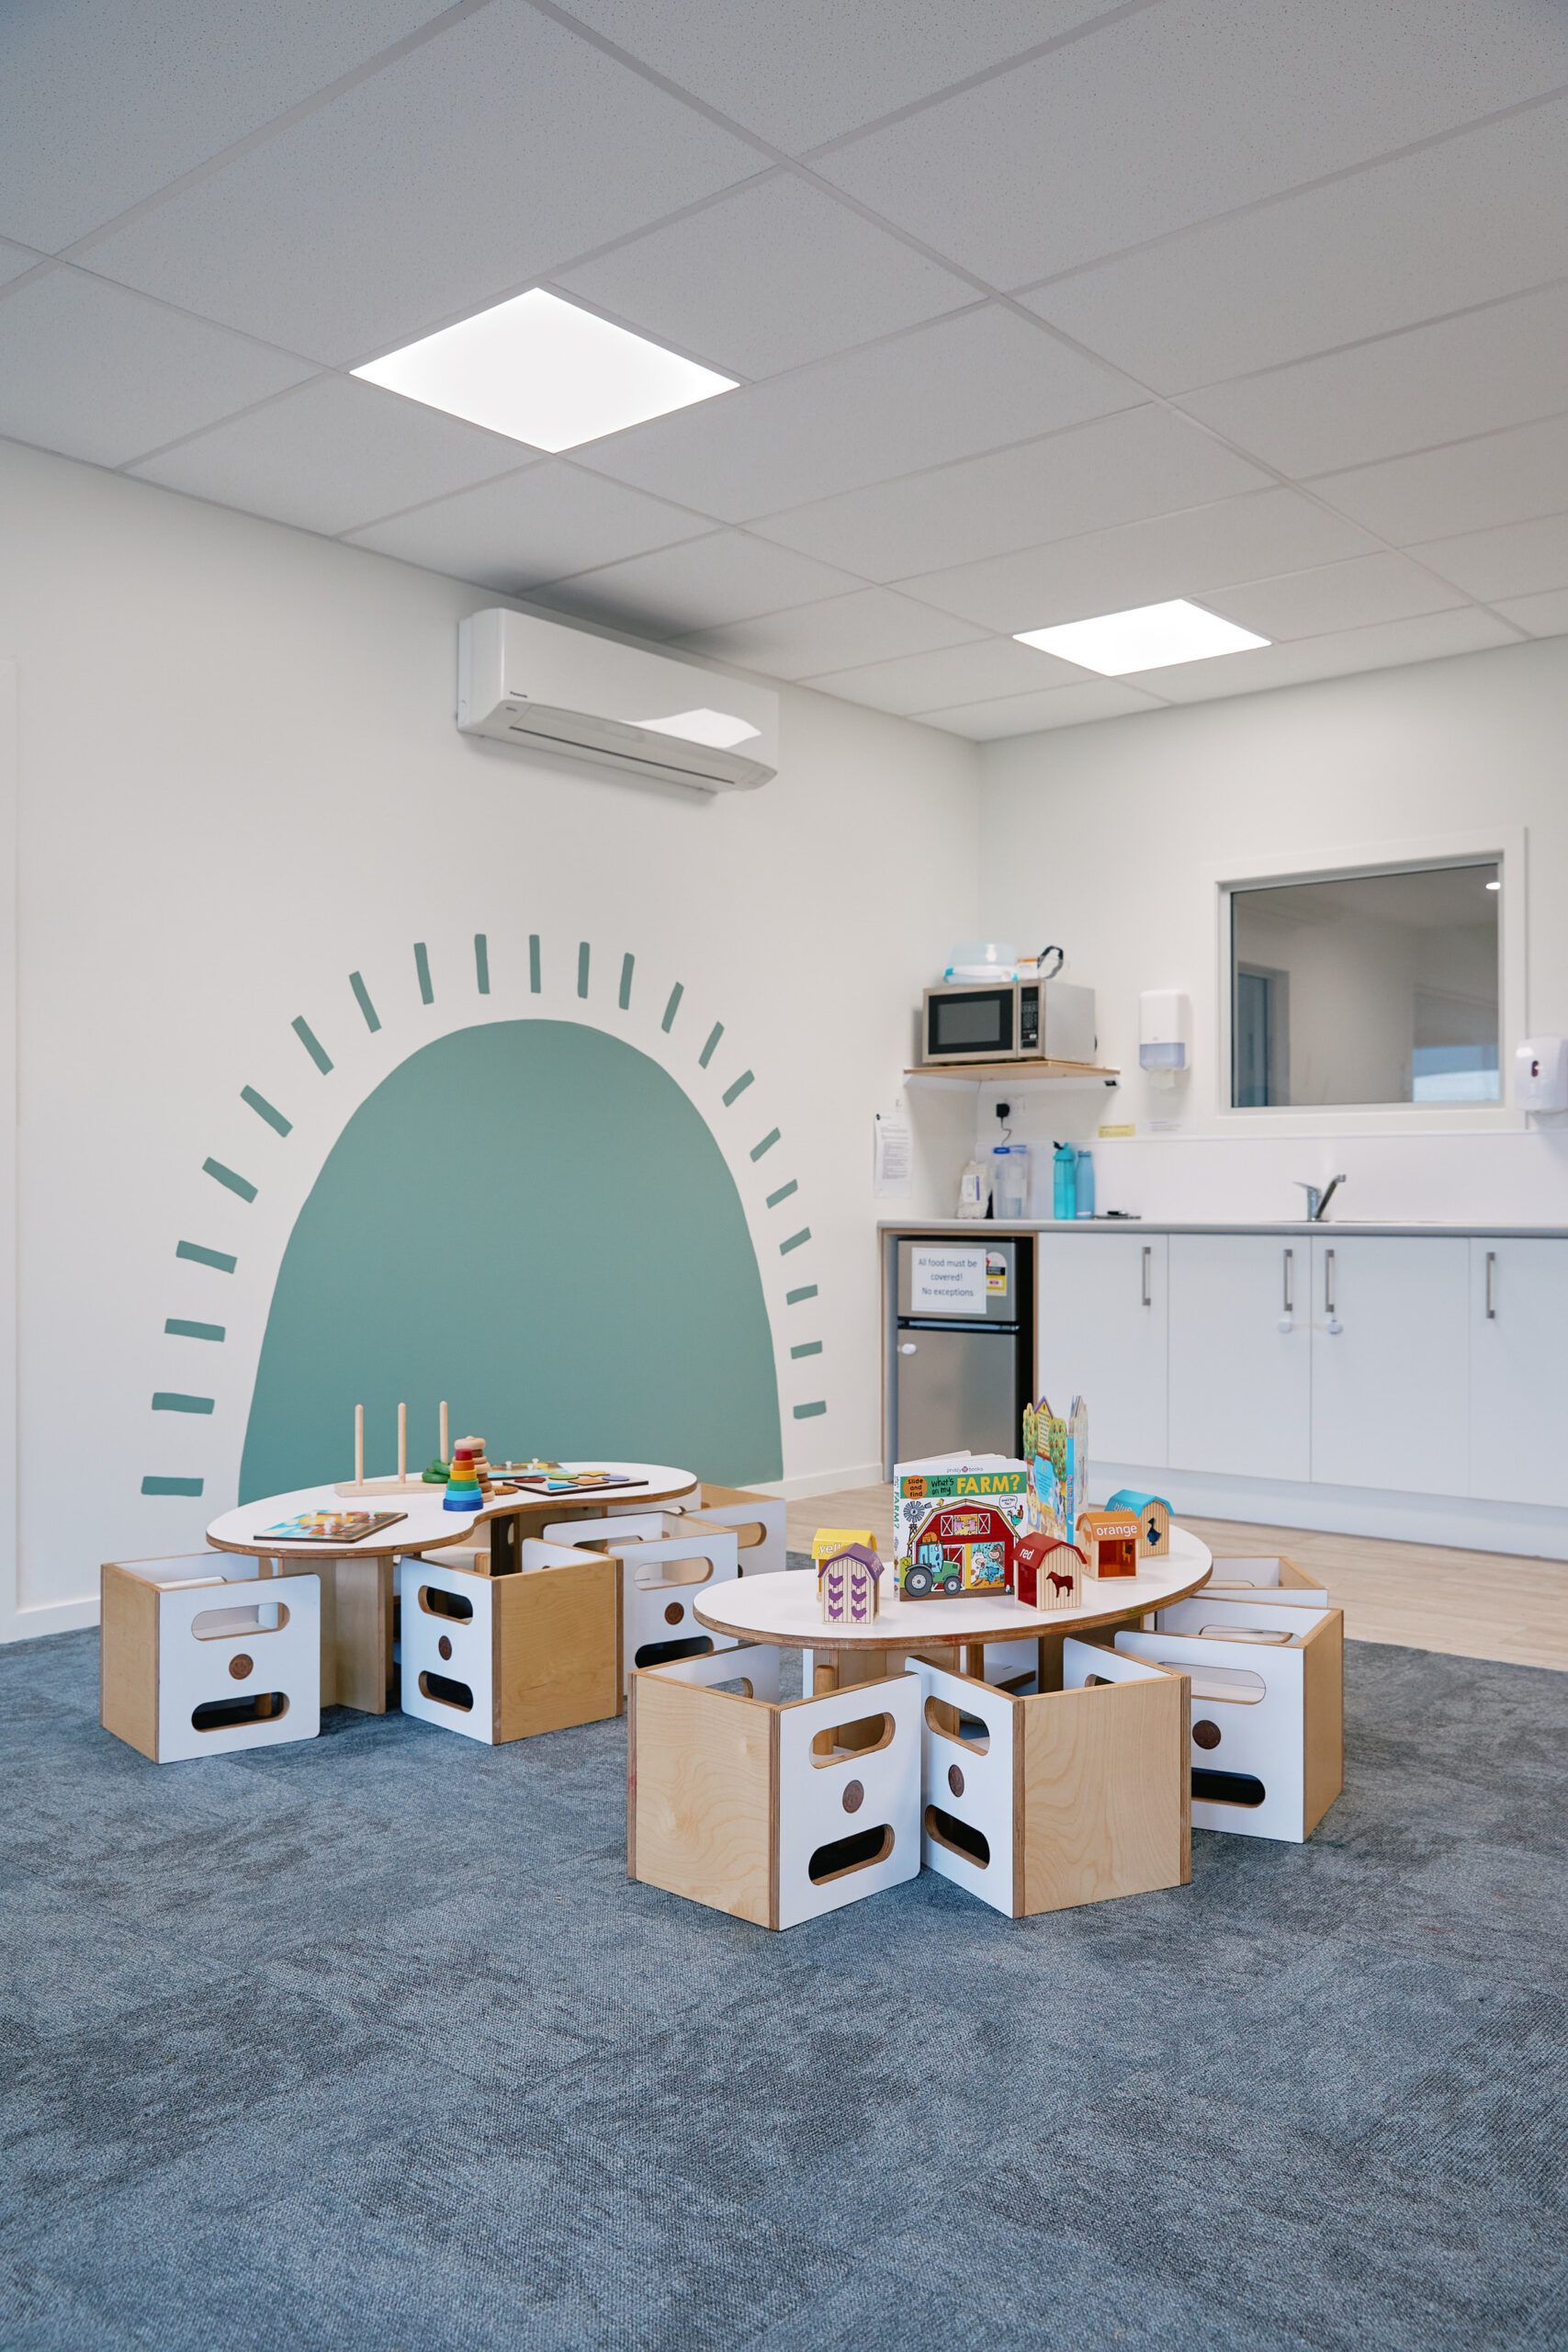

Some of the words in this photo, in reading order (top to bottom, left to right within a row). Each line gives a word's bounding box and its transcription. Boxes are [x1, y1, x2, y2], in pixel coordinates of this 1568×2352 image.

[928, 1259, 944, 1267] food
[967, 1260, 977, 1268] be
[931, 1273, 963, 1282] covered!
[934, 1288, 974, 1296] exceptions
[956, 1475, 1020, 1494] FARM?
[940, 1487, 951, 1497] my
[1114, 1501, 1133, 1511] blue
[1096, 1525, 1138, 1537] orange
[818, 1544, 841, 1556] yell
[1020, 1548, 1034, 1560] red
